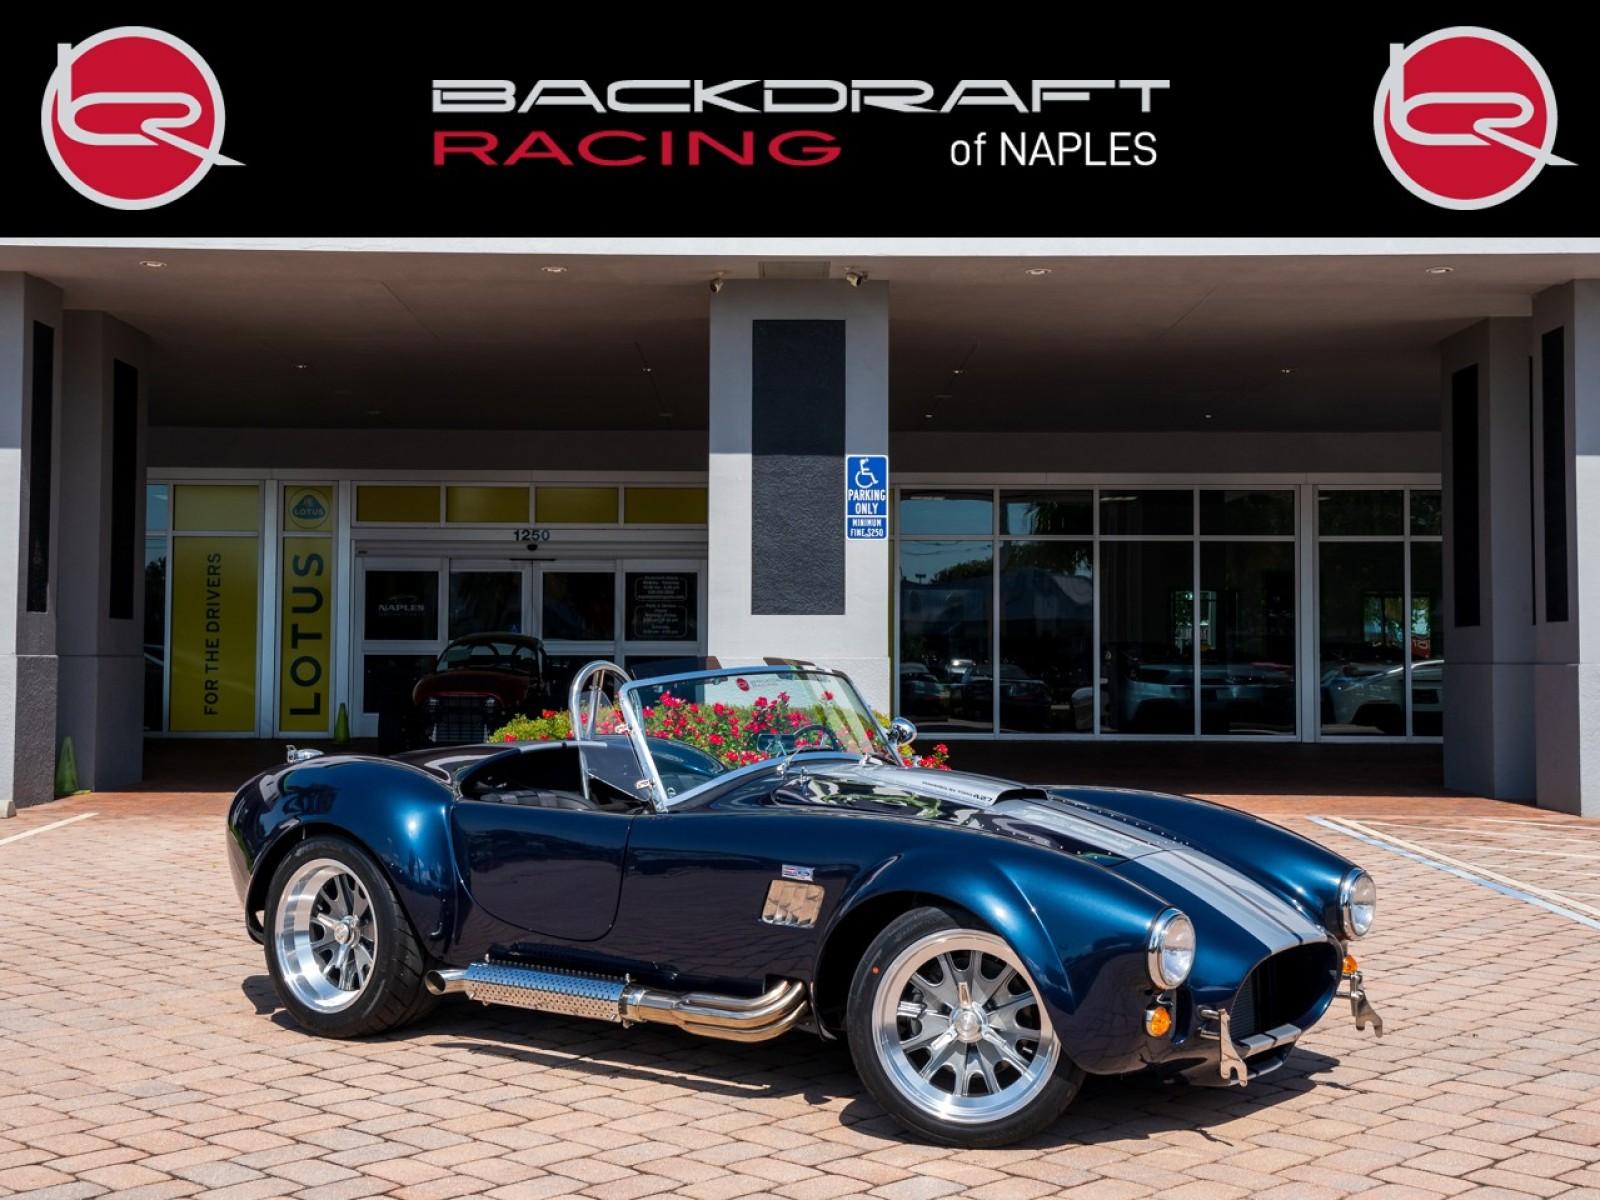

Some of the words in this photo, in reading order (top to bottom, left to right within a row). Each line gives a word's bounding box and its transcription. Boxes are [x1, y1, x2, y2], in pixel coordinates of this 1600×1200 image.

[848, 489, 886, 501] PARKING
[294, 507, 324, 516] LOTUS
[855, 502, 879, 514] ONLY
[852, 518, 882, 527] MINIMUM
[513, 528, 551, 541] 1250
[206, 552, 222, 633] DRIVERS
[289, 552, 325, 716] LOTUS
[205, 638, 220, 674] THE
[204, 679, 219, 716] FOR
